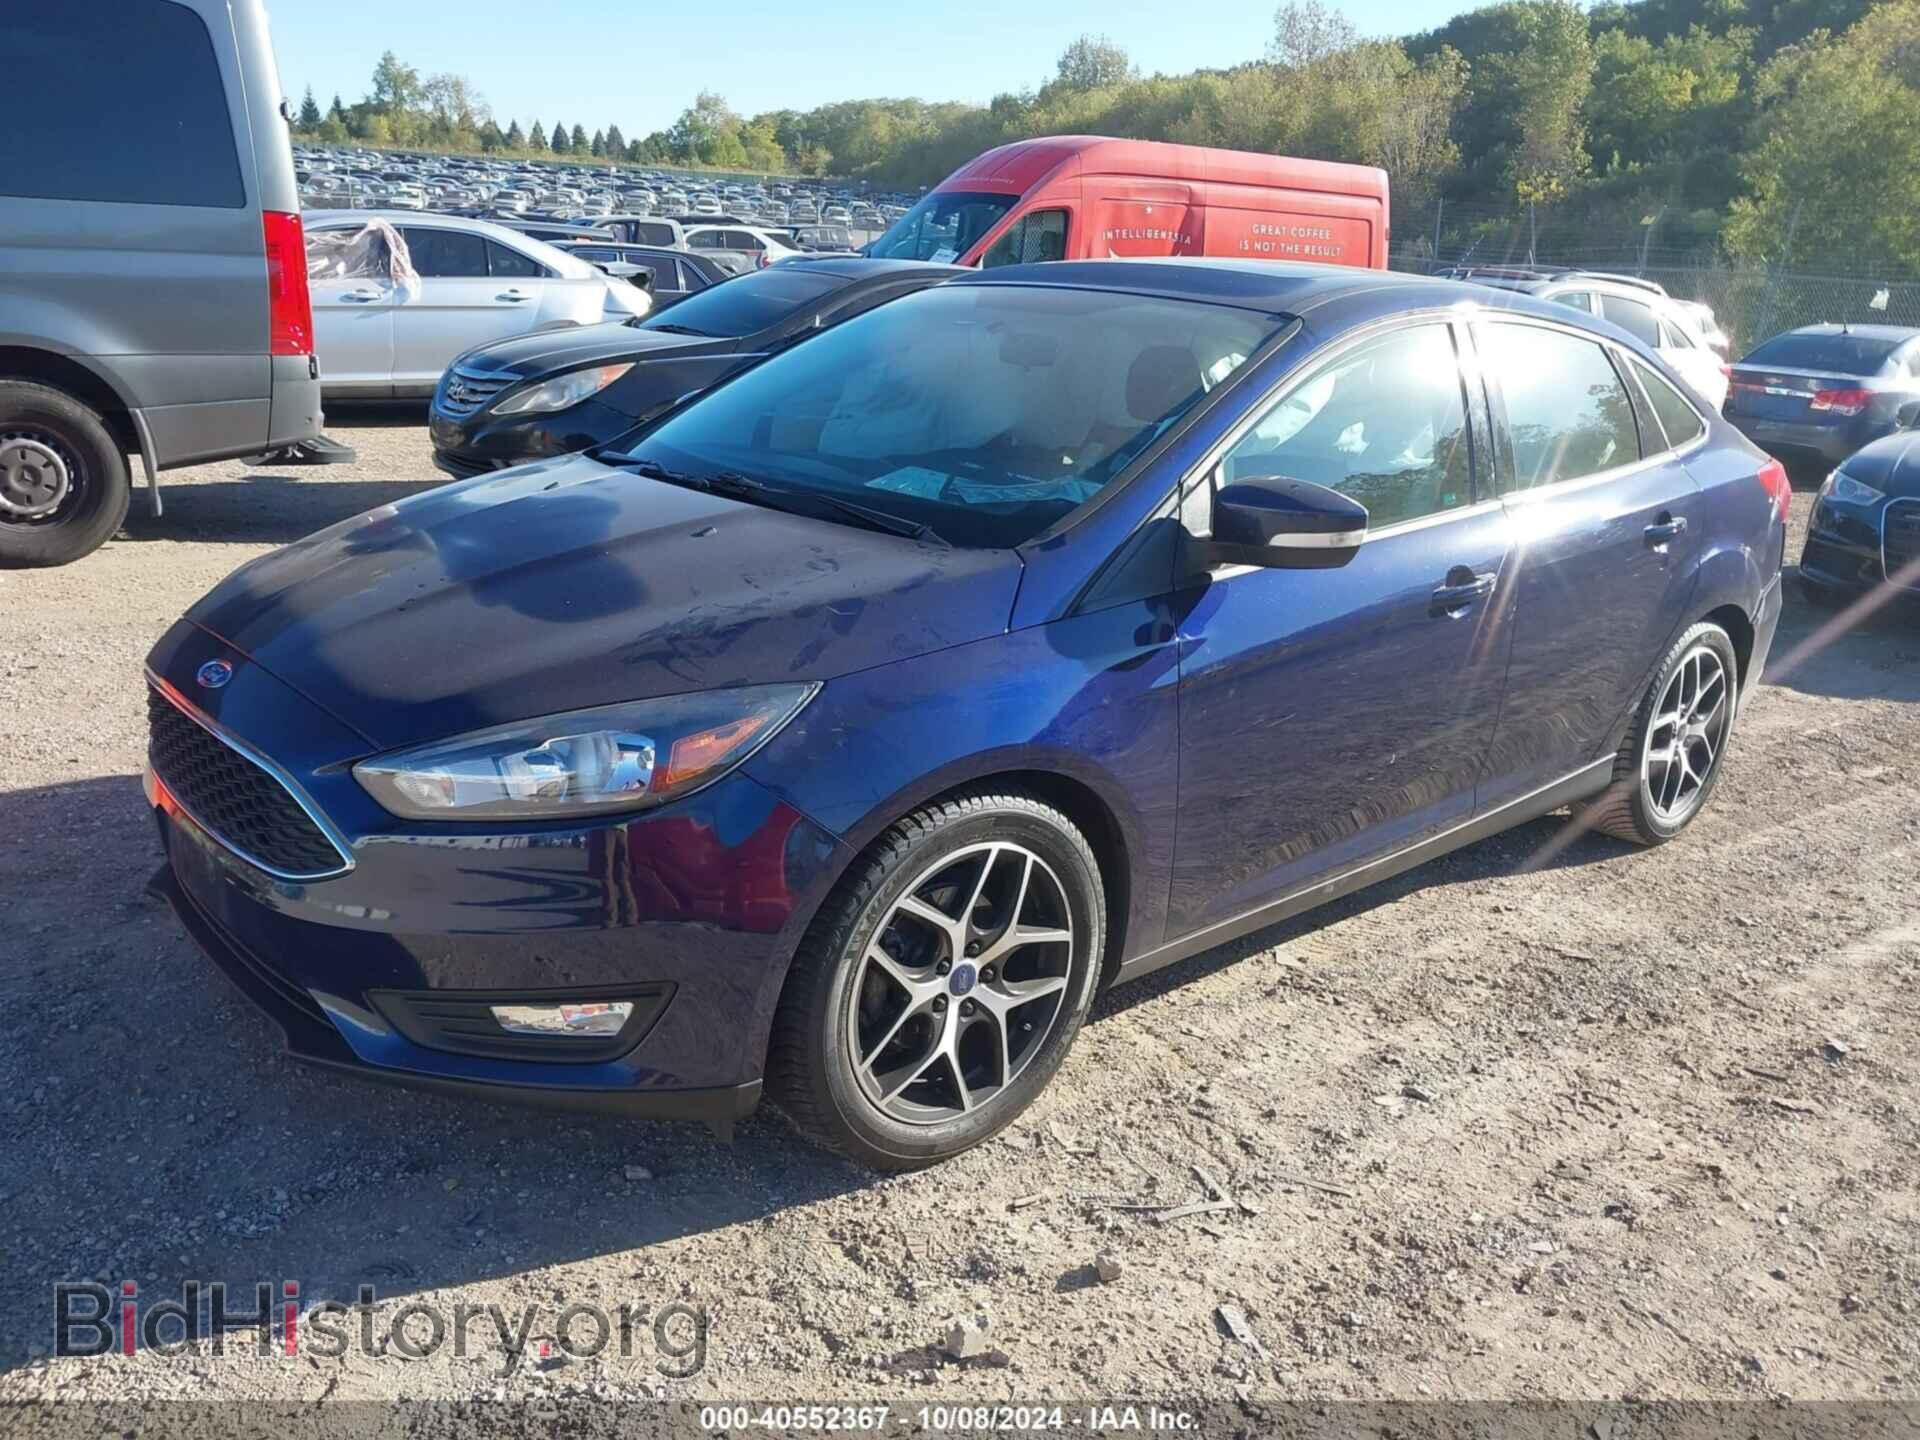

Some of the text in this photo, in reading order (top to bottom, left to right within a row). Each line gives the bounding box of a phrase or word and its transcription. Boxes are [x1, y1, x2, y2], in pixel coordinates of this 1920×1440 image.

[1252, 224, 1331, 240] GREAT COFFEE
[1240, 240, 1249, 251] IS
[1254, 241, 1276, 253] NOT
[1281, 243, 1299, 254] THE
